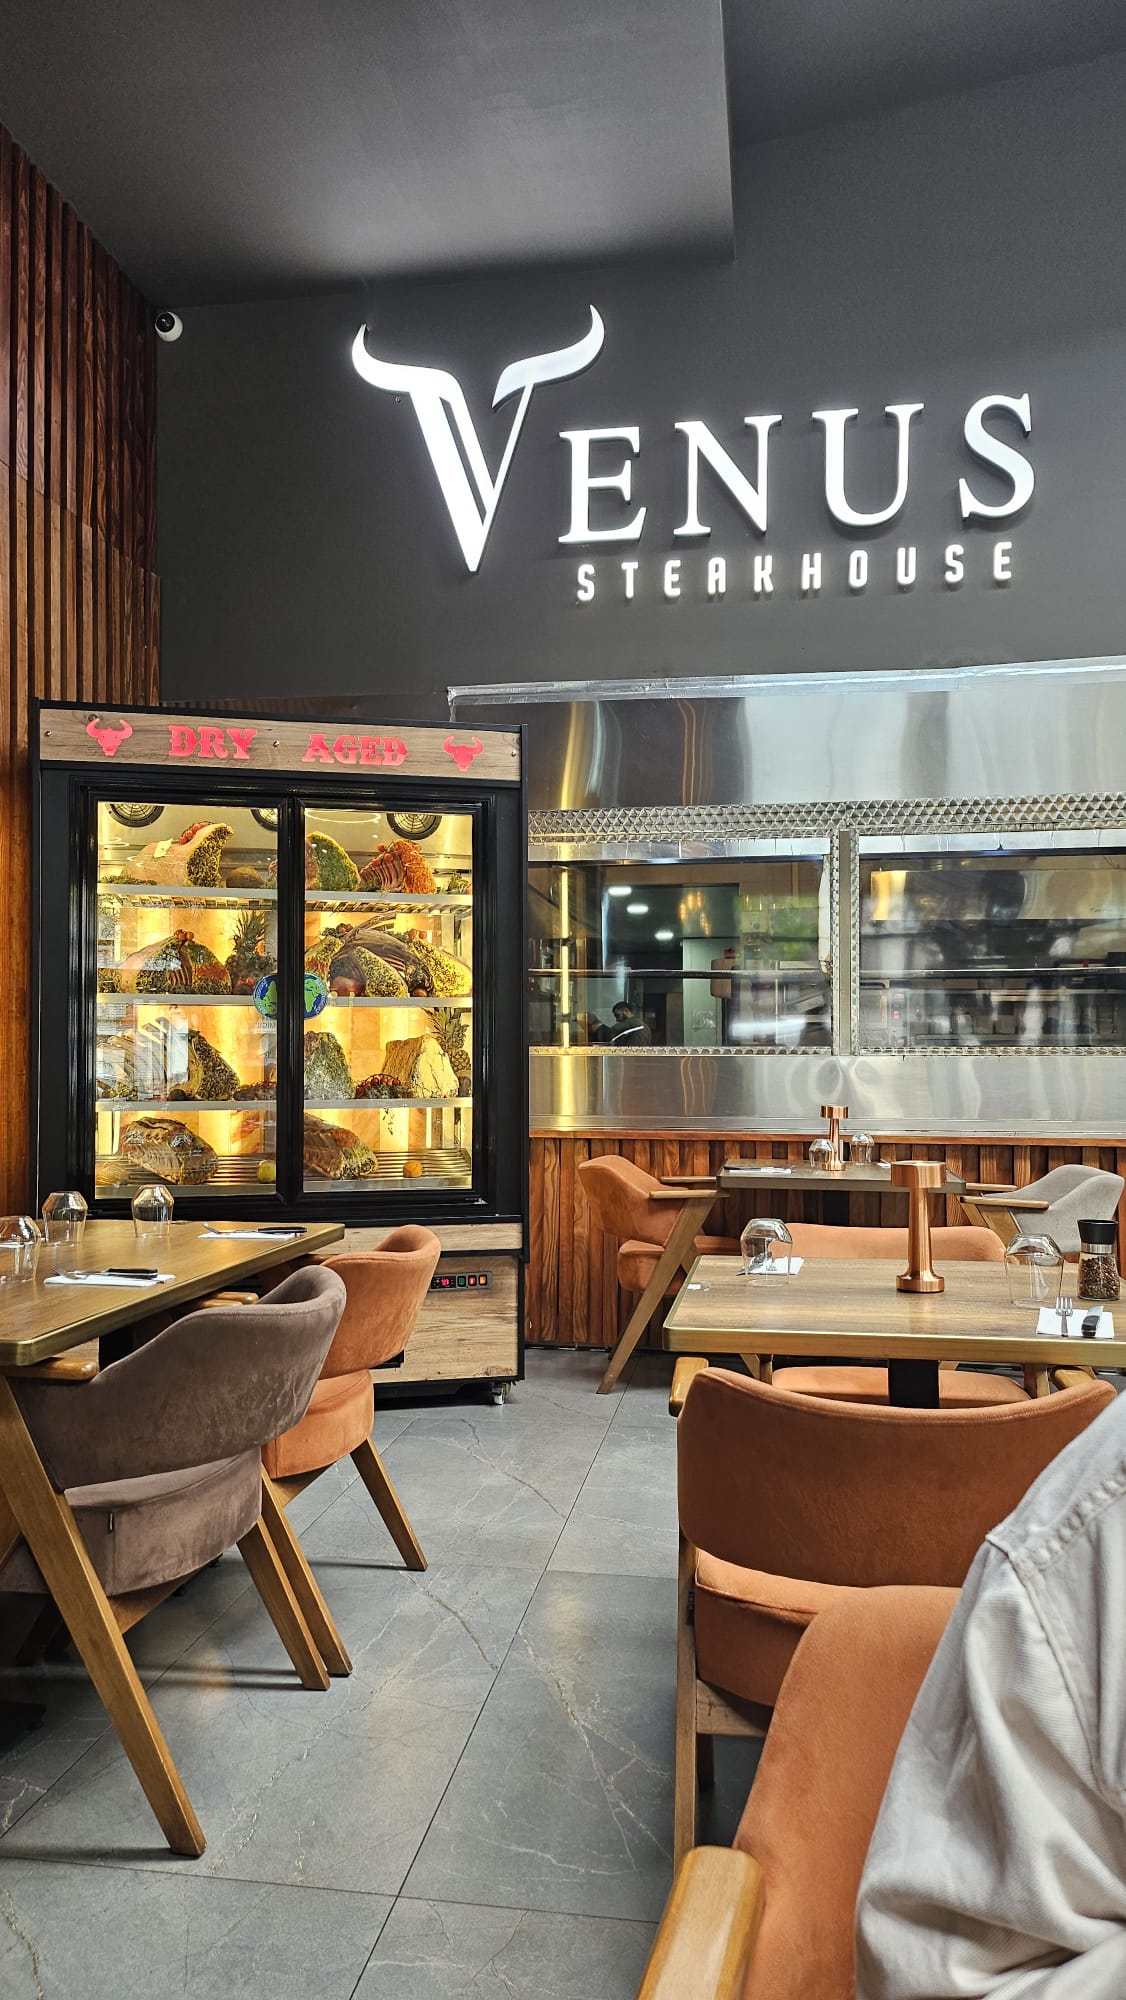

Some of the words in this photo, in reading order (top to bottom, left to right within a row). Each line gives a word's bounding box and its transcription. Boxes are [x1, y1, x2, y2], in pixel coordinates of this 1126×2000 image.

[351, 304, 1036, 573] VENUS
[576, 540, 1014, 602] STEAKHOUSE
[168, 724, 257, 760] DRY
[302, 733, 409, 767] AGED
